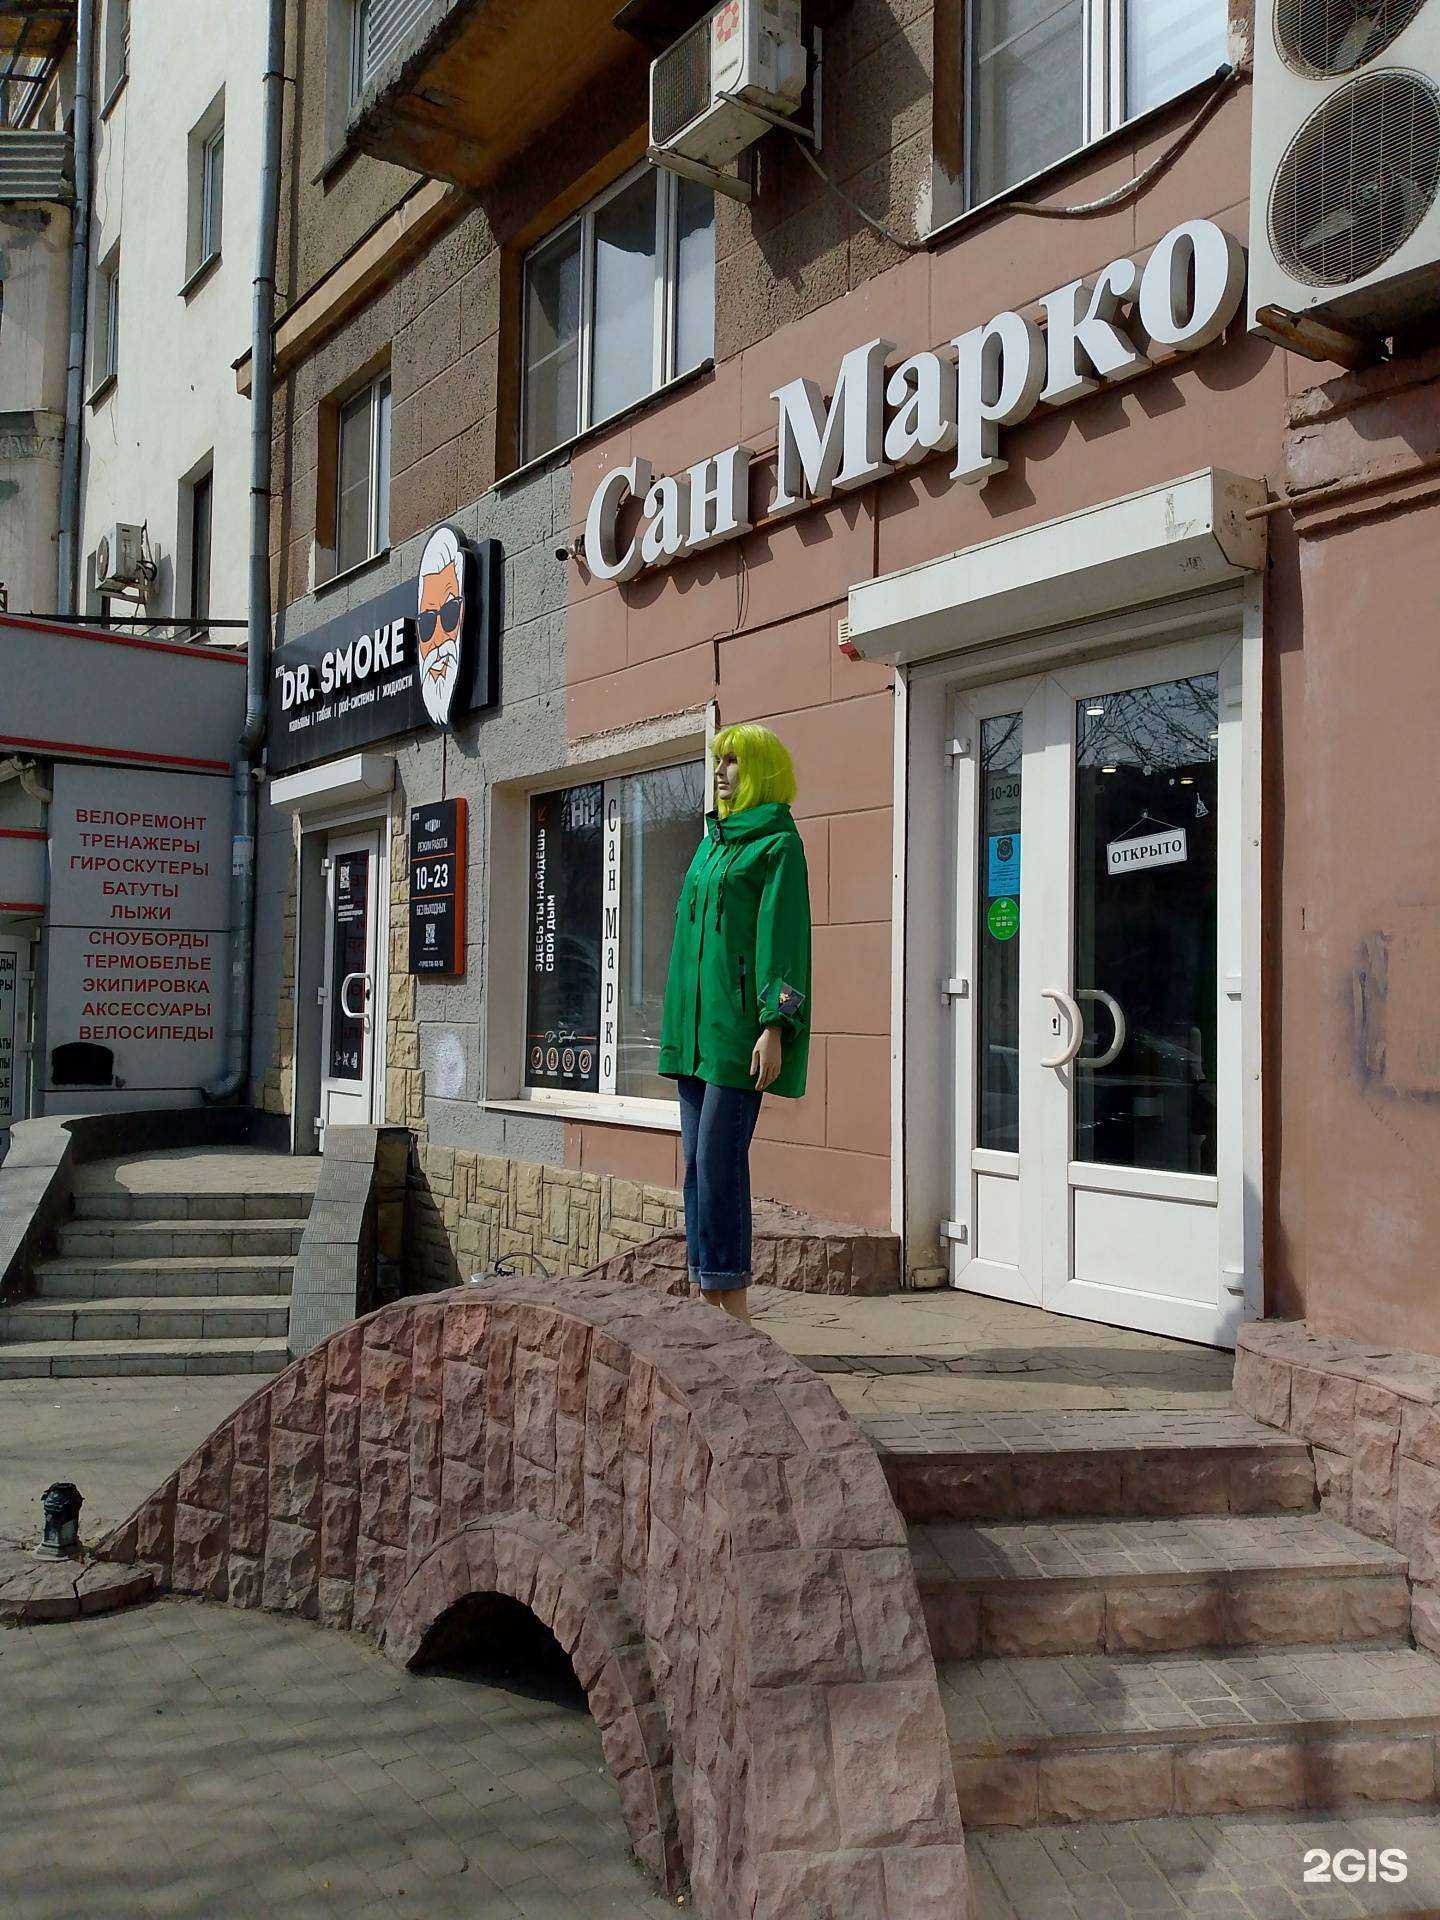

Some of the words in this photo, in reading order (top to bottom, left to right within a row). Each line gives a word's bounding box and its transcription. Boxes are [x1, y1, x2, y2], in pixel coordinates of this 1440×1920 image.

[585, 444, 754, 582] Сан
[767, 219, 1240, 514] Марко
[282, 664, 315, 711] DR.
[321, 617, 405, 694] SMOKE
[382, 674, 413, 697] жидкости
[991, 784, 1020, 800] 10-20
[76, 809, 207, 830] ВЕЛОРЕМОНТ
[571, 800, 595, 828] Hi!
[79, 833, 200, 853] ТРЕНАЖЕРЫ
[417, 840, 432, 852] РЕЖИМ
[432, 837, 448, 850] РАБОТЫ
[1112, 840, 1182, 864] ОТКРЫТО
[70, 856, 208, 876] ГИРОСКУТЕРЫ
[416, 864, 449, 891] 10-23
[102, 882, 178, 898] БАТУТЫ
[110, 905, 171, 920] ЛЫЖИ
[536, 902, 545, 924] ТЫ
[546, 895, 555, 930] ДЫМ
[89, 931, 208, 949] СНОУБОРДЫ
[535, 926, 545, 972] ЗДЕСЬ
[83, 954, 211, 970] ТЕРМОБЕЛЬЕ
[545, 934, 555, 972] СВОЙ
[83, 978, 210, 993] ЭКИПИРОВКА
[82, 1002, 211, 1017] АКСЕССУАРЫ
[79, 1026, 214, 1042] ВЕЛОСИПЕДЫ
